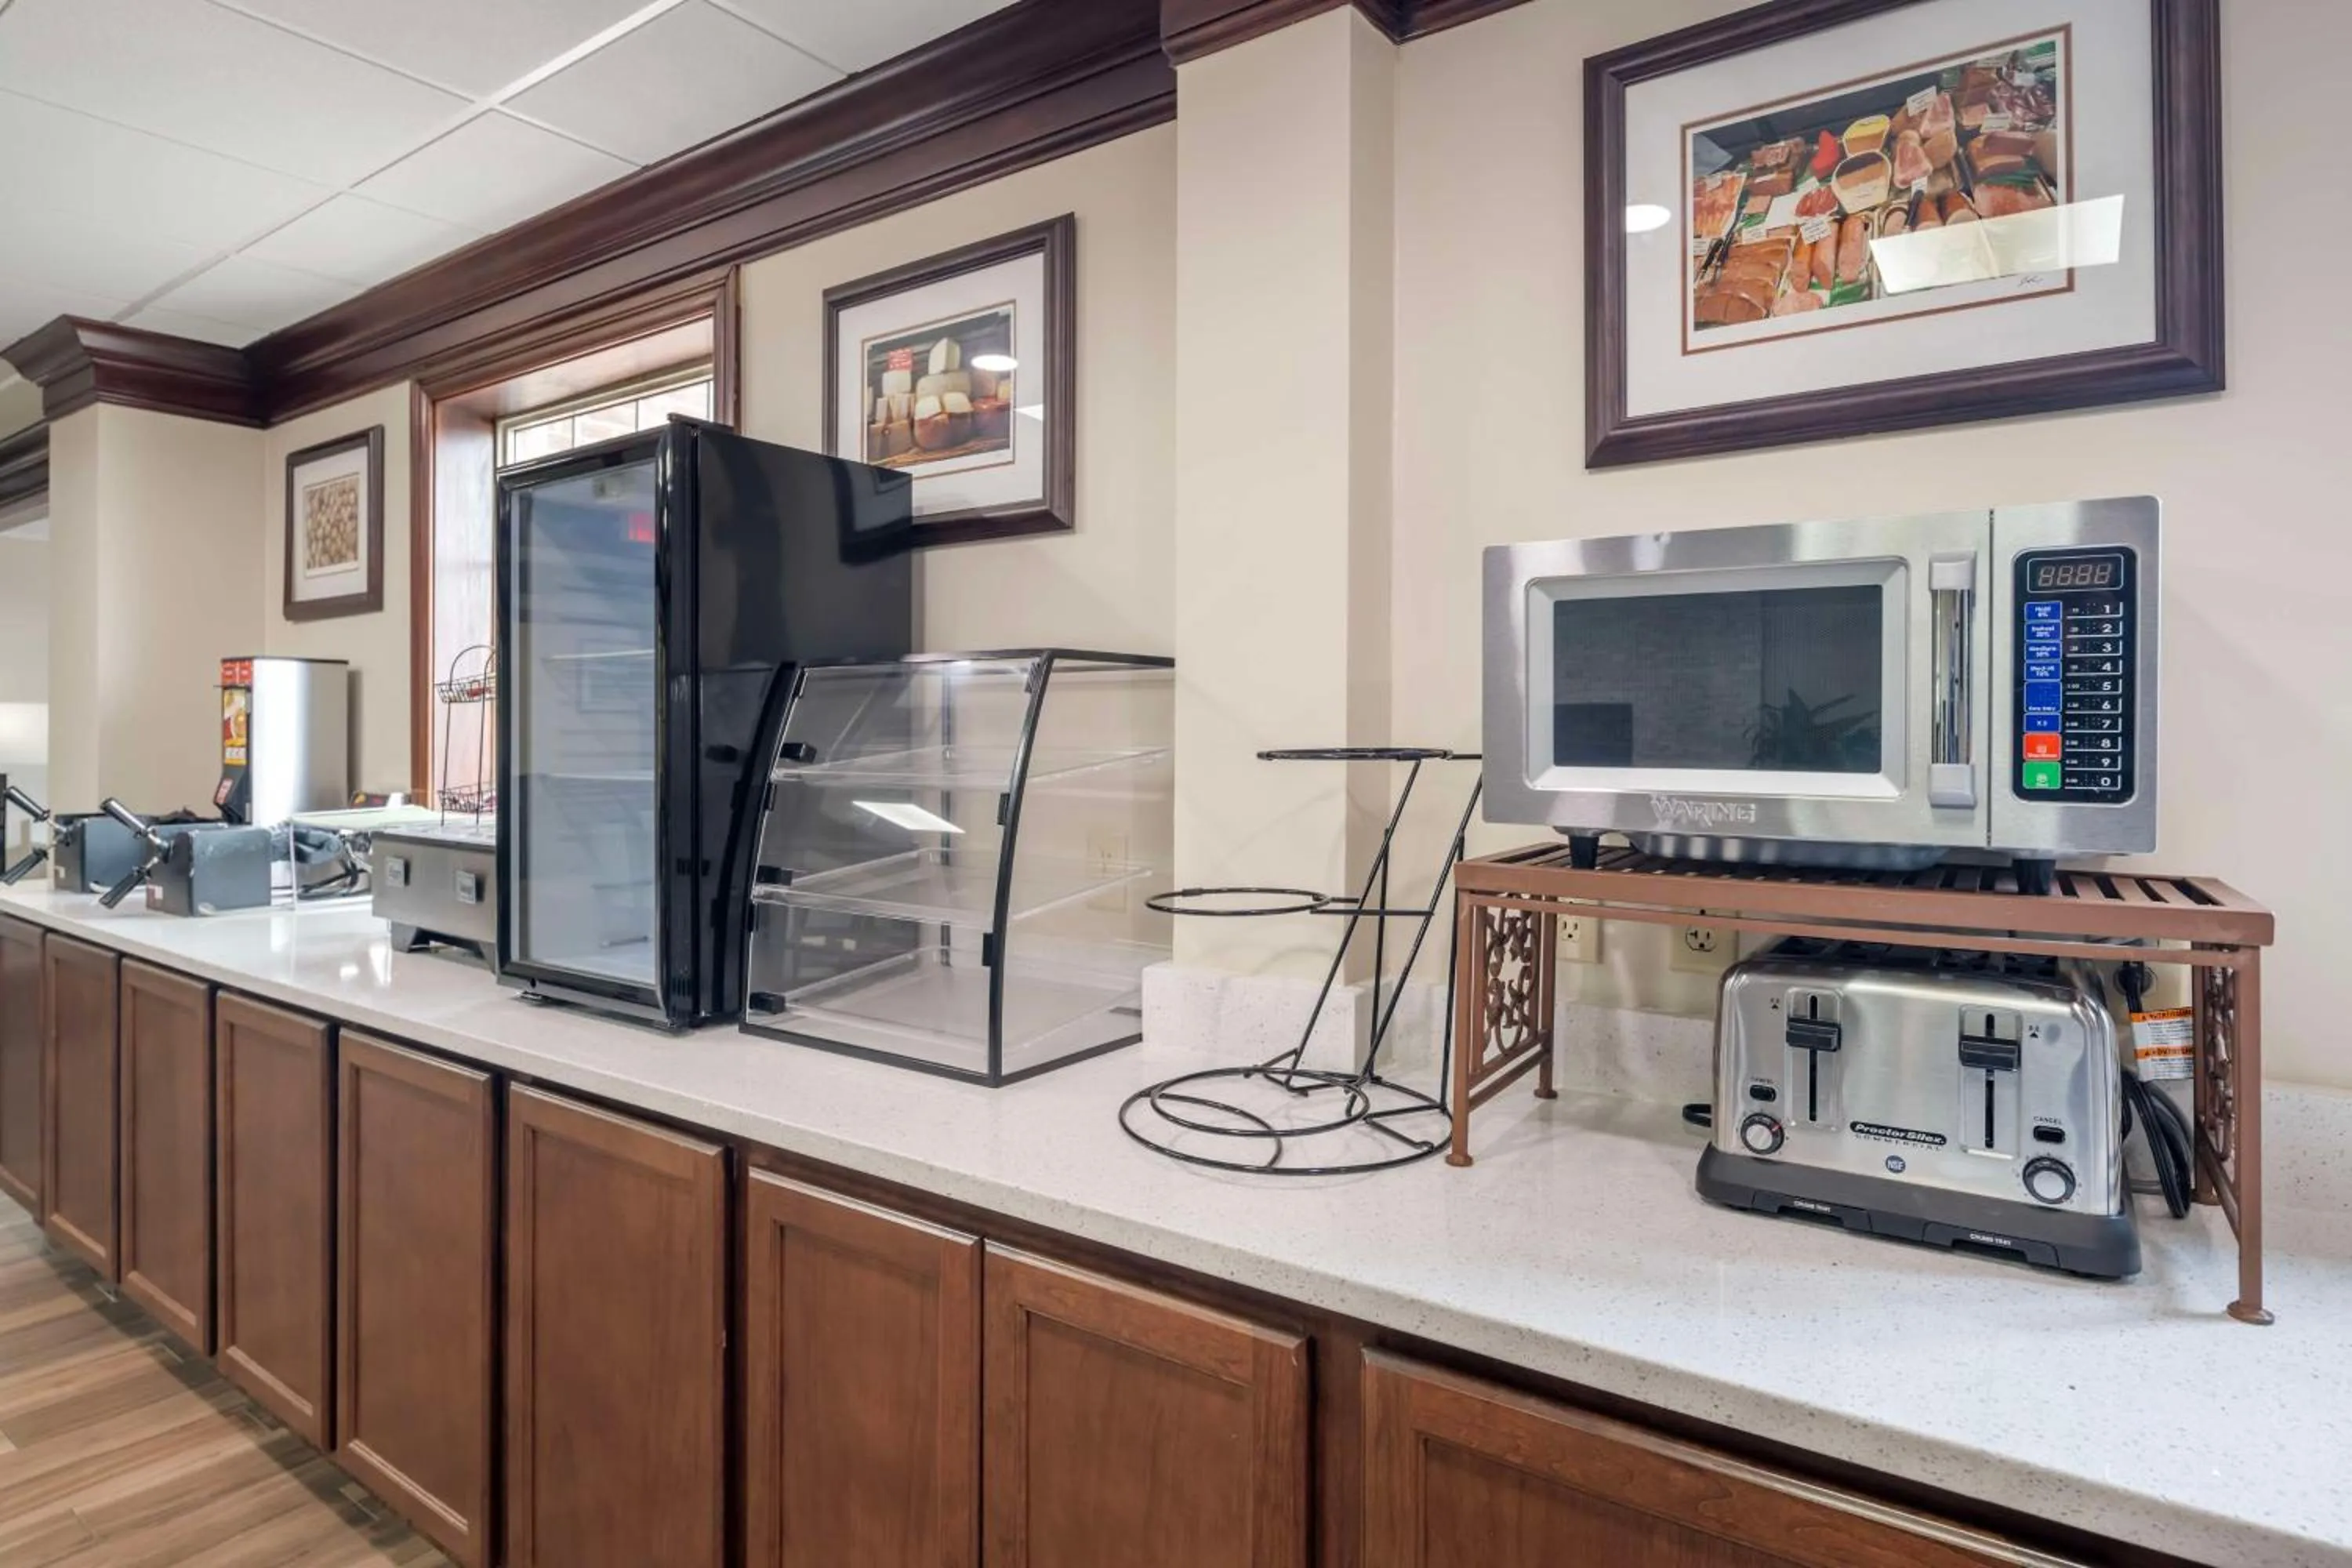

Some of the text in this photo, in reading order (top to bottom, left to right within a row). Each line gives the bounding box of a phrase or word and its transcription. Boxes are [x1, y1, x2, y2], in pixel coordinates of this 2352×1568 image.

[2103, 604, 2111, 614] 1
[2102, 623, 2112, 633] 2
[2102, 642, 2112, 652] 3
[2102, 662, 2111, 671] 4
[2102, 681, 2111, 691] 5
[2102, 700, 2111, 710] 6
[2102, 720, 2111, 728] 7
[2101, 739, 2111, 748] 8
[2101, 757, 2111, 768] 9
[2101, 777, 2111, 786] 0
[1650, 793, 1757, 828] WARING
[2033, 1116, 2063, 1125] CANCEL
